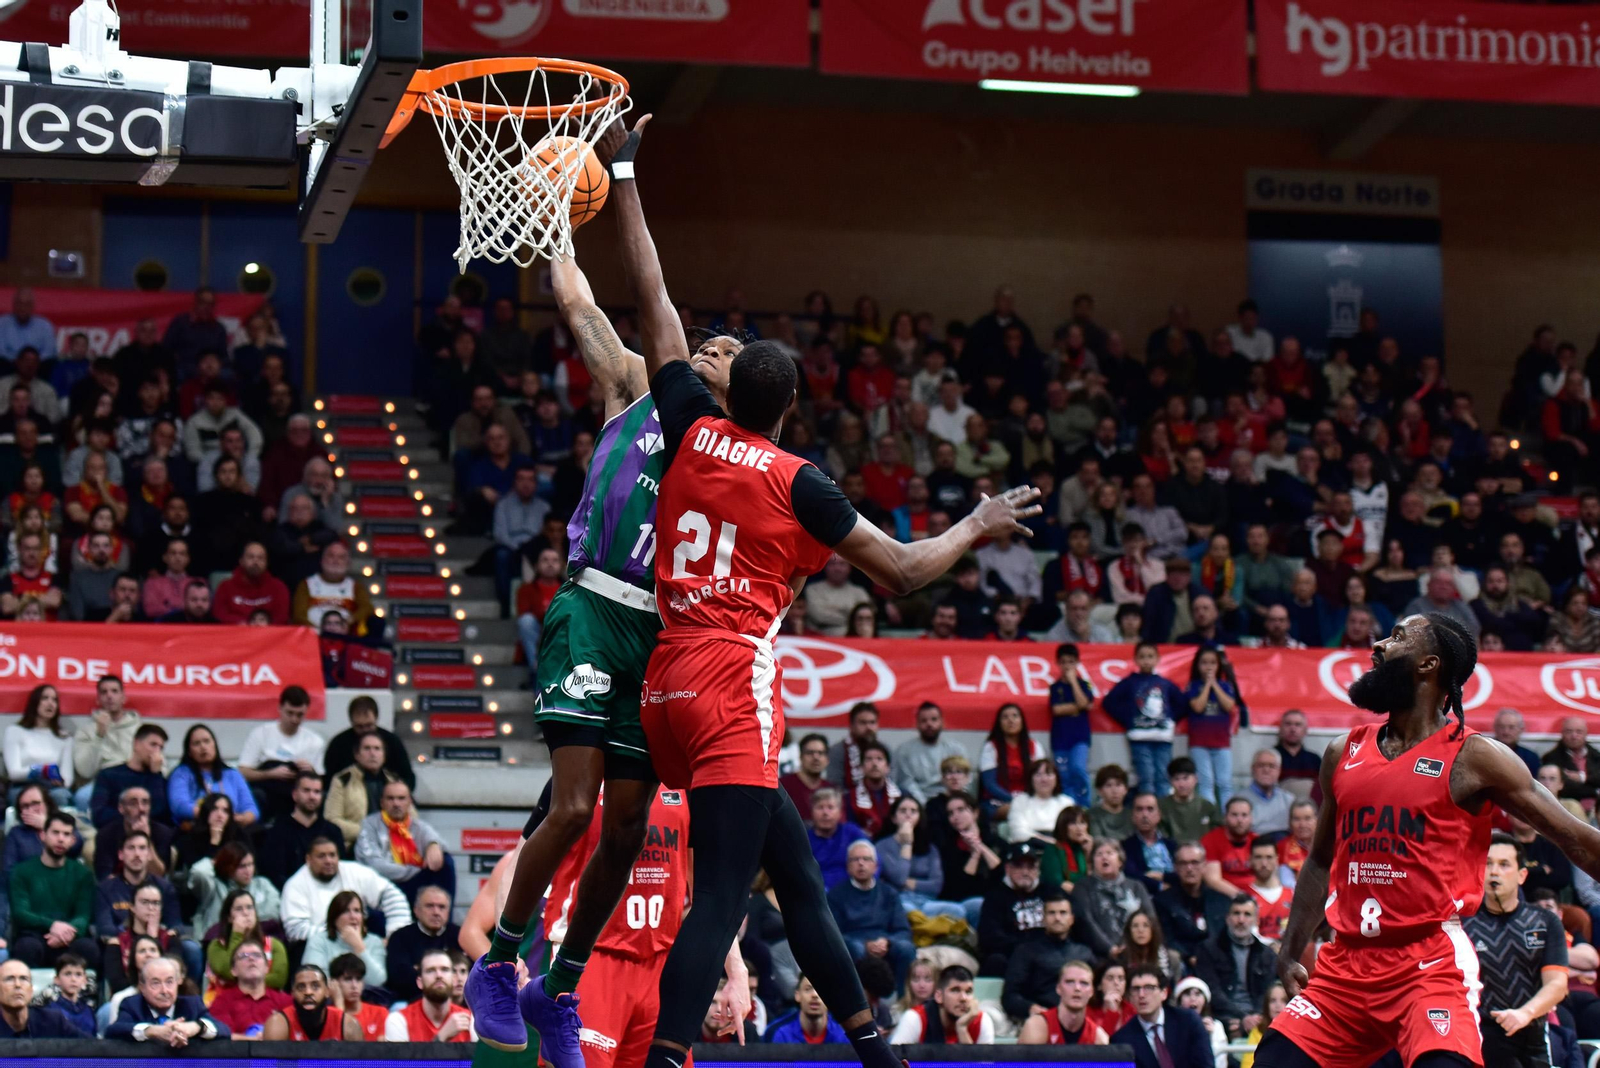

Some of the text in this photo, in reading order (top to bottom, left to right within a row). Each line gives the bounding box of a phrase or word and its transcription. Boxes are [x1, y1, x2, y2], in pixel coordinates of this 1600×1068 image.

[922, 41, 1151, 77] Grupo Helvetia
[1256, 177, 1431, 206] Grada Norte
[692, 427, 776, 473] DIAGNE
[671, 509, 738, 580] 21
[57, 656, 111, 682] DE
[121, 661, 281, 686] MURCIA
[647, 825, 679, 851] AM
[1340, 805, 1427, 844] UCAM
[638, 850, 671, 864] RCIA
[1349, 837, 1409, 857] MURCIA
[626, 894, 665, 930] 00
[1360, 897, 1383, 938] 8
